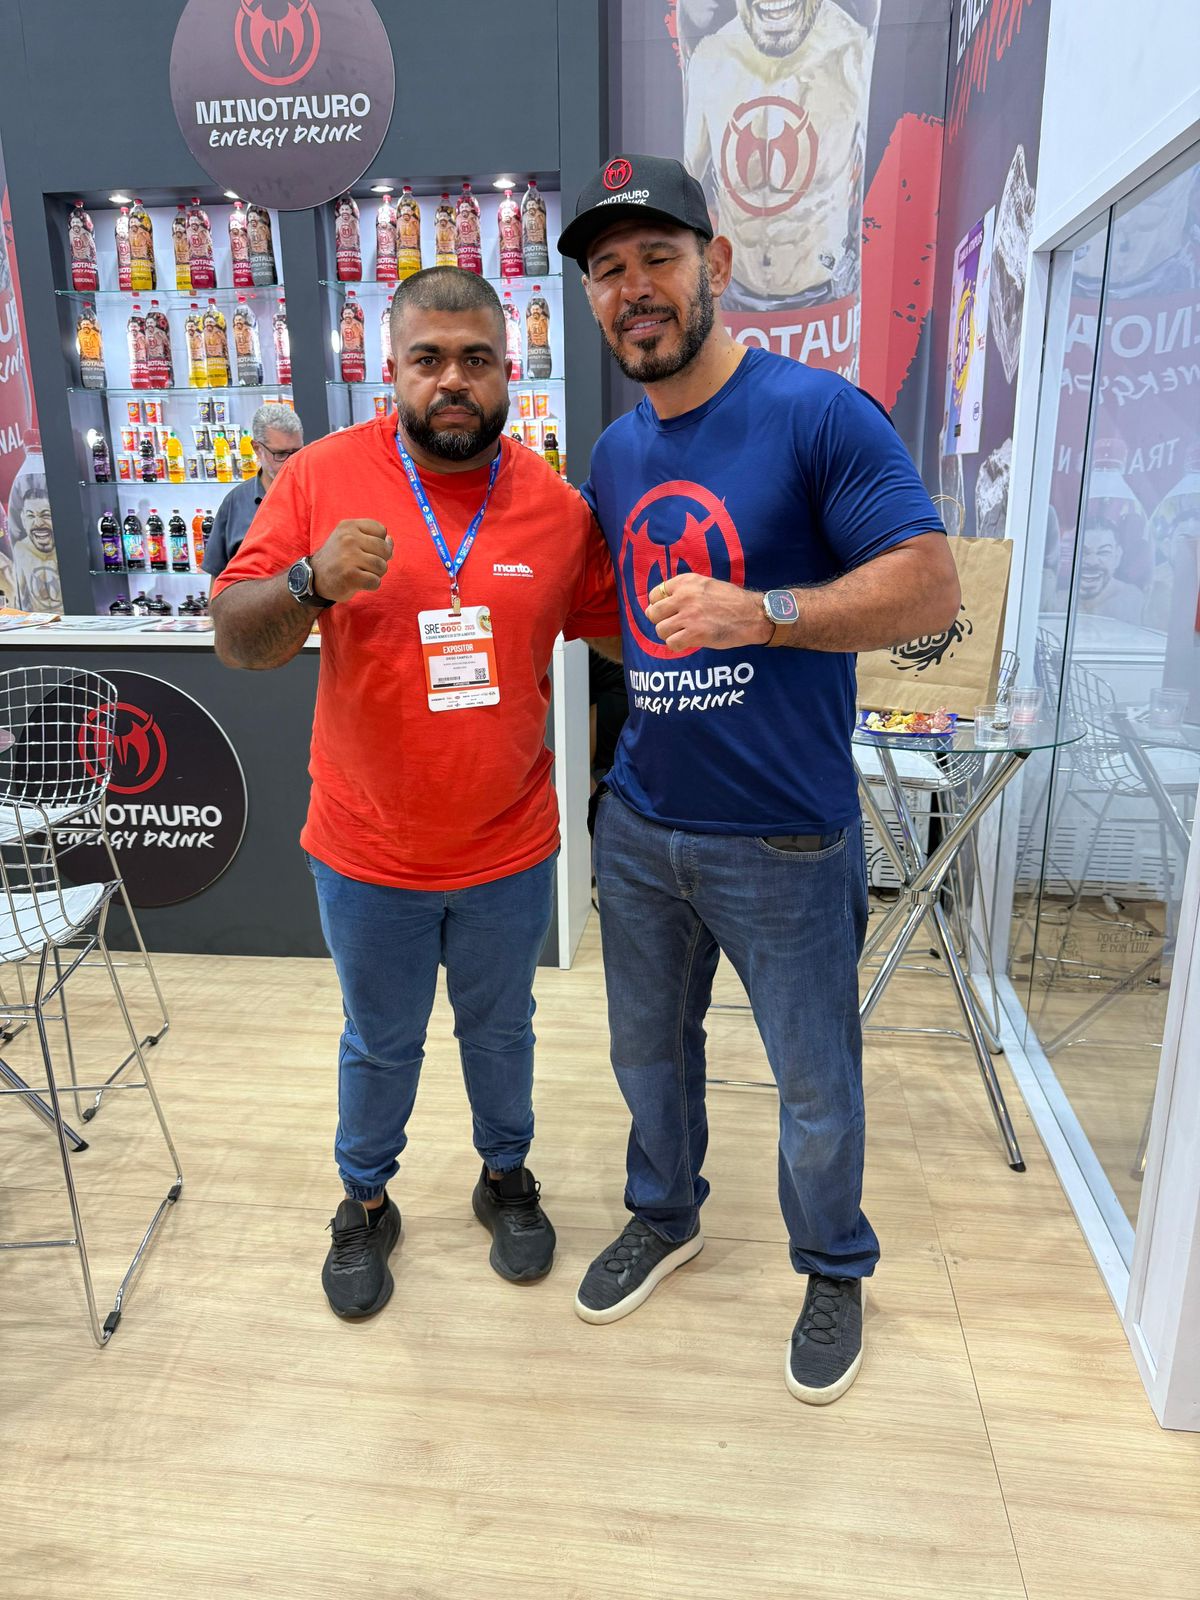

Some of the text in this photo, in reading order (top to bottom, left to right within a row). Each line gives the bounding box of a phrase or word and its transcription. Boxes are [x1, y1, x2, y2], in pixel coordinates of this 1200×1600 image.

[195, 92, 371, 125] MINOTAURO
[209, 123, 362, 150] ENERGY DRINK
[424, 623, 441, 635] SRE
[443, 643, 474, 654] EXPOSITOR
[678, 689, 745, 712] DRINK
[143, 830, 215, 849] DRINK
